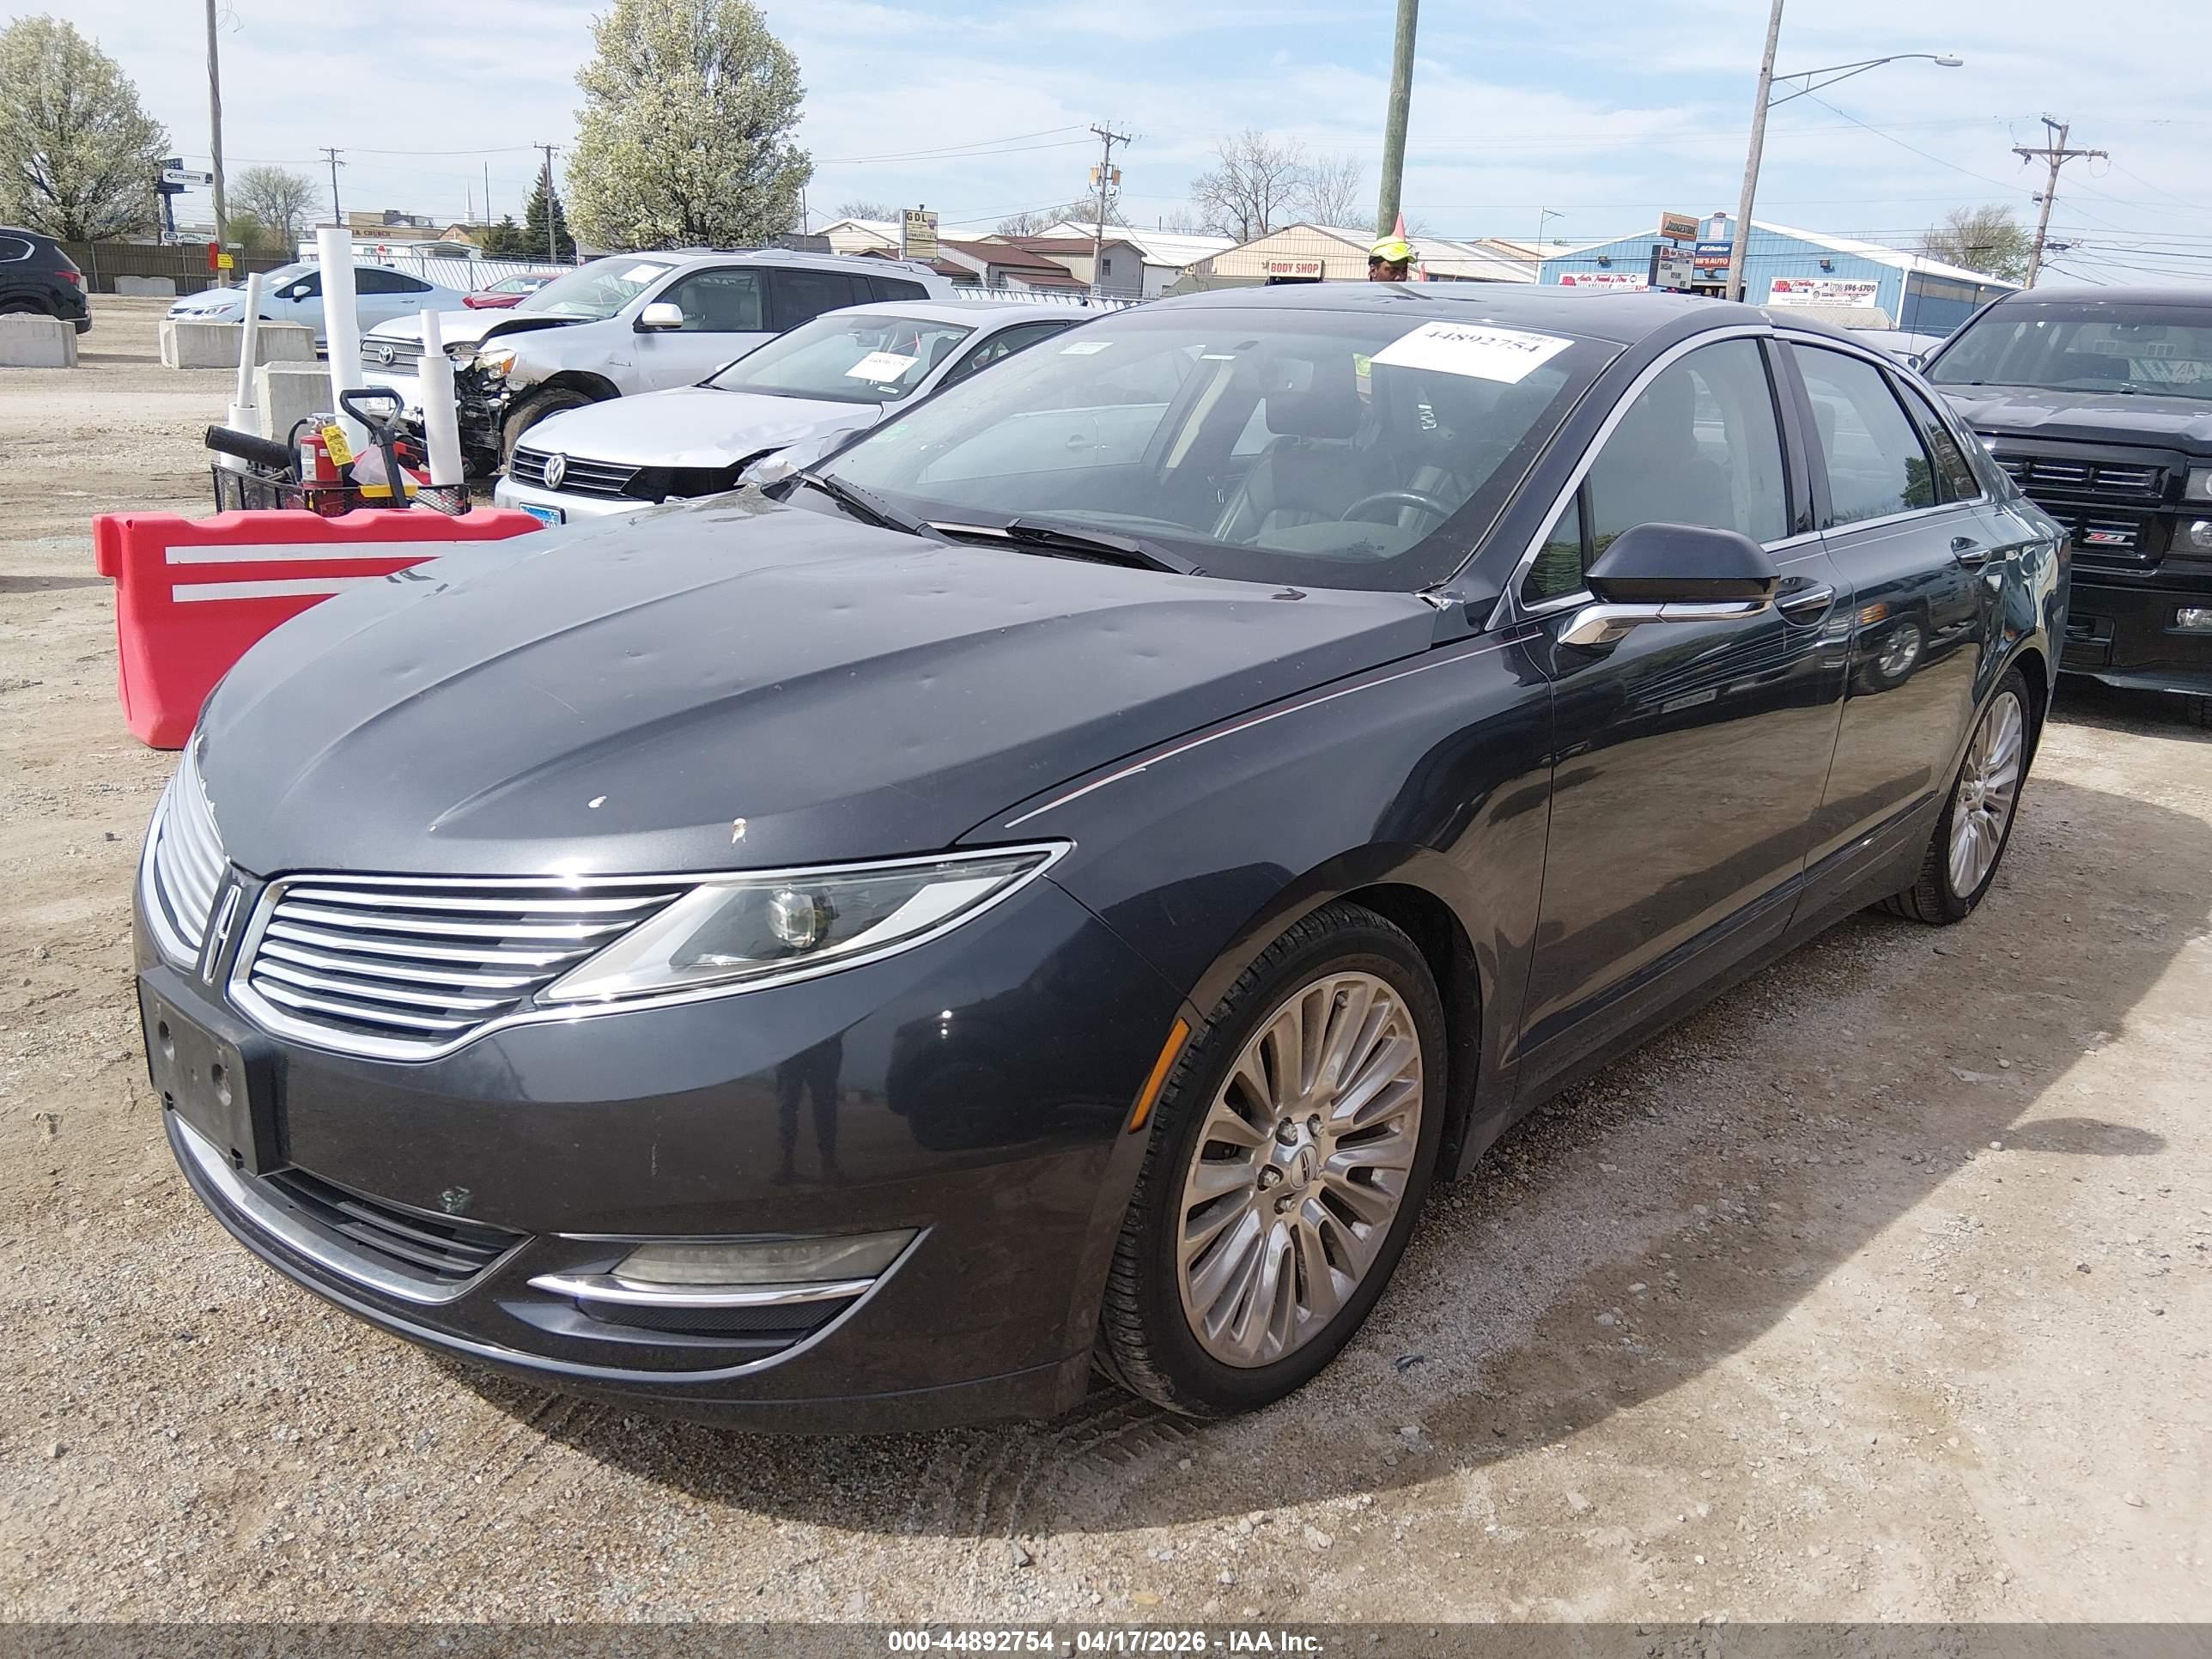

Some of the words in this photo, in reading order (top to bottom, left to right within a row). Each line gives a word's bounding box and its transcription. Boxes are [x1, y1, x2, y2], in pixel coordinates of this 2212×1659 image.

[907, 212, 927, 222] GDL
[1271, 263, 1293, 272] BODY
[1296, 263, 1319, 273] SHOP
[1425, 331, 1540, 353] 44892754
